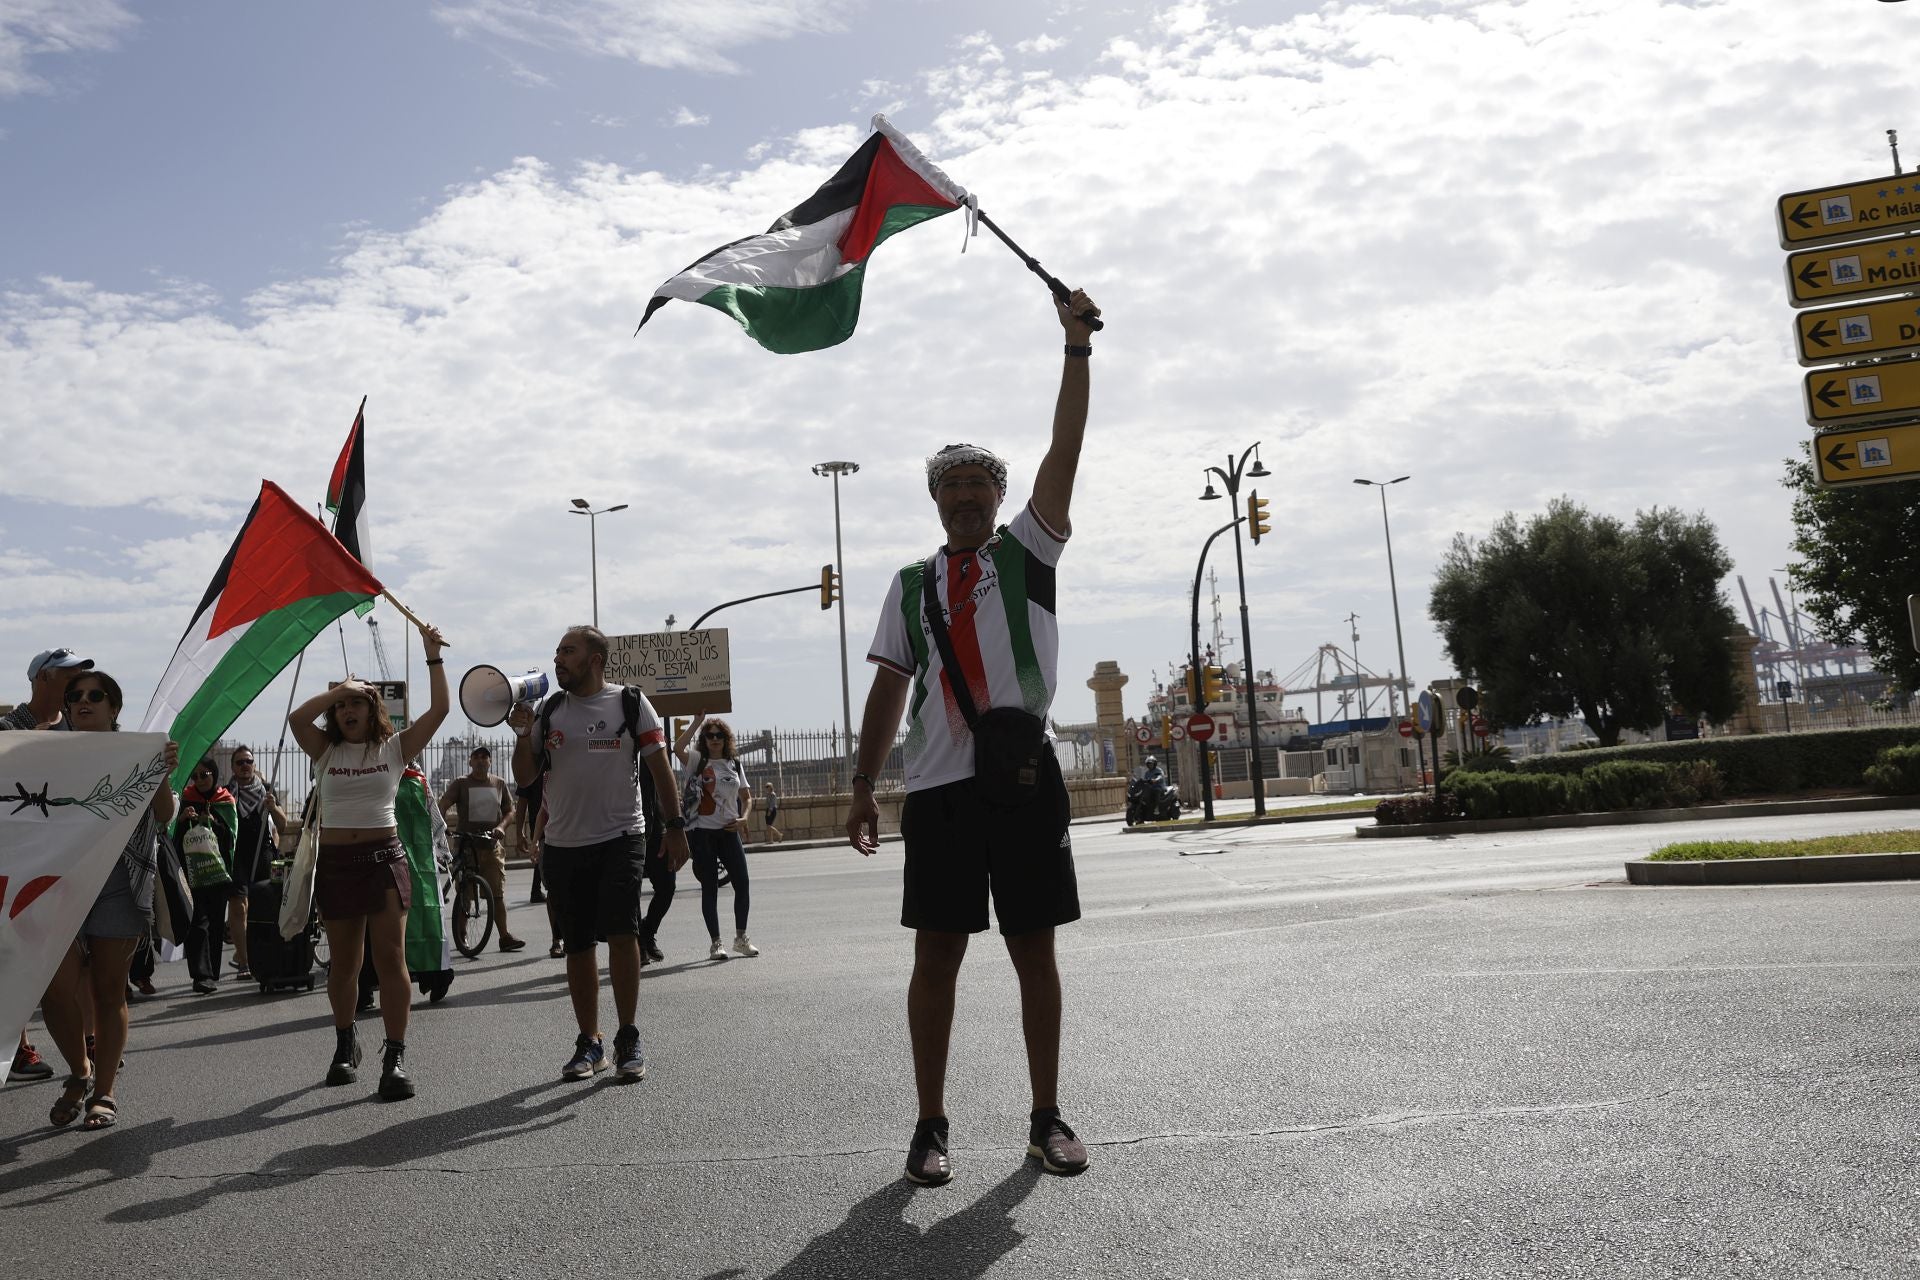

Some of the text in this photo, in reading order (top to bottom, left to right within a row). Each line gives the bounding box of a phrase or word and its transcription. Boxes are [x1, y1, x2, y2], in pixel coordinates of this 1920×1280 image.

[1859, 207, 1880, 222] AC
[1867, 261, 1920, 284] Moli
[1899, 322, 1920, 341] D
[616, 634, 672, 651] INFIERNO
[640, 650, 649, 664] Y
[654, 647, 692, 663] TODOS
[699, 645, 719, 661] LOS
